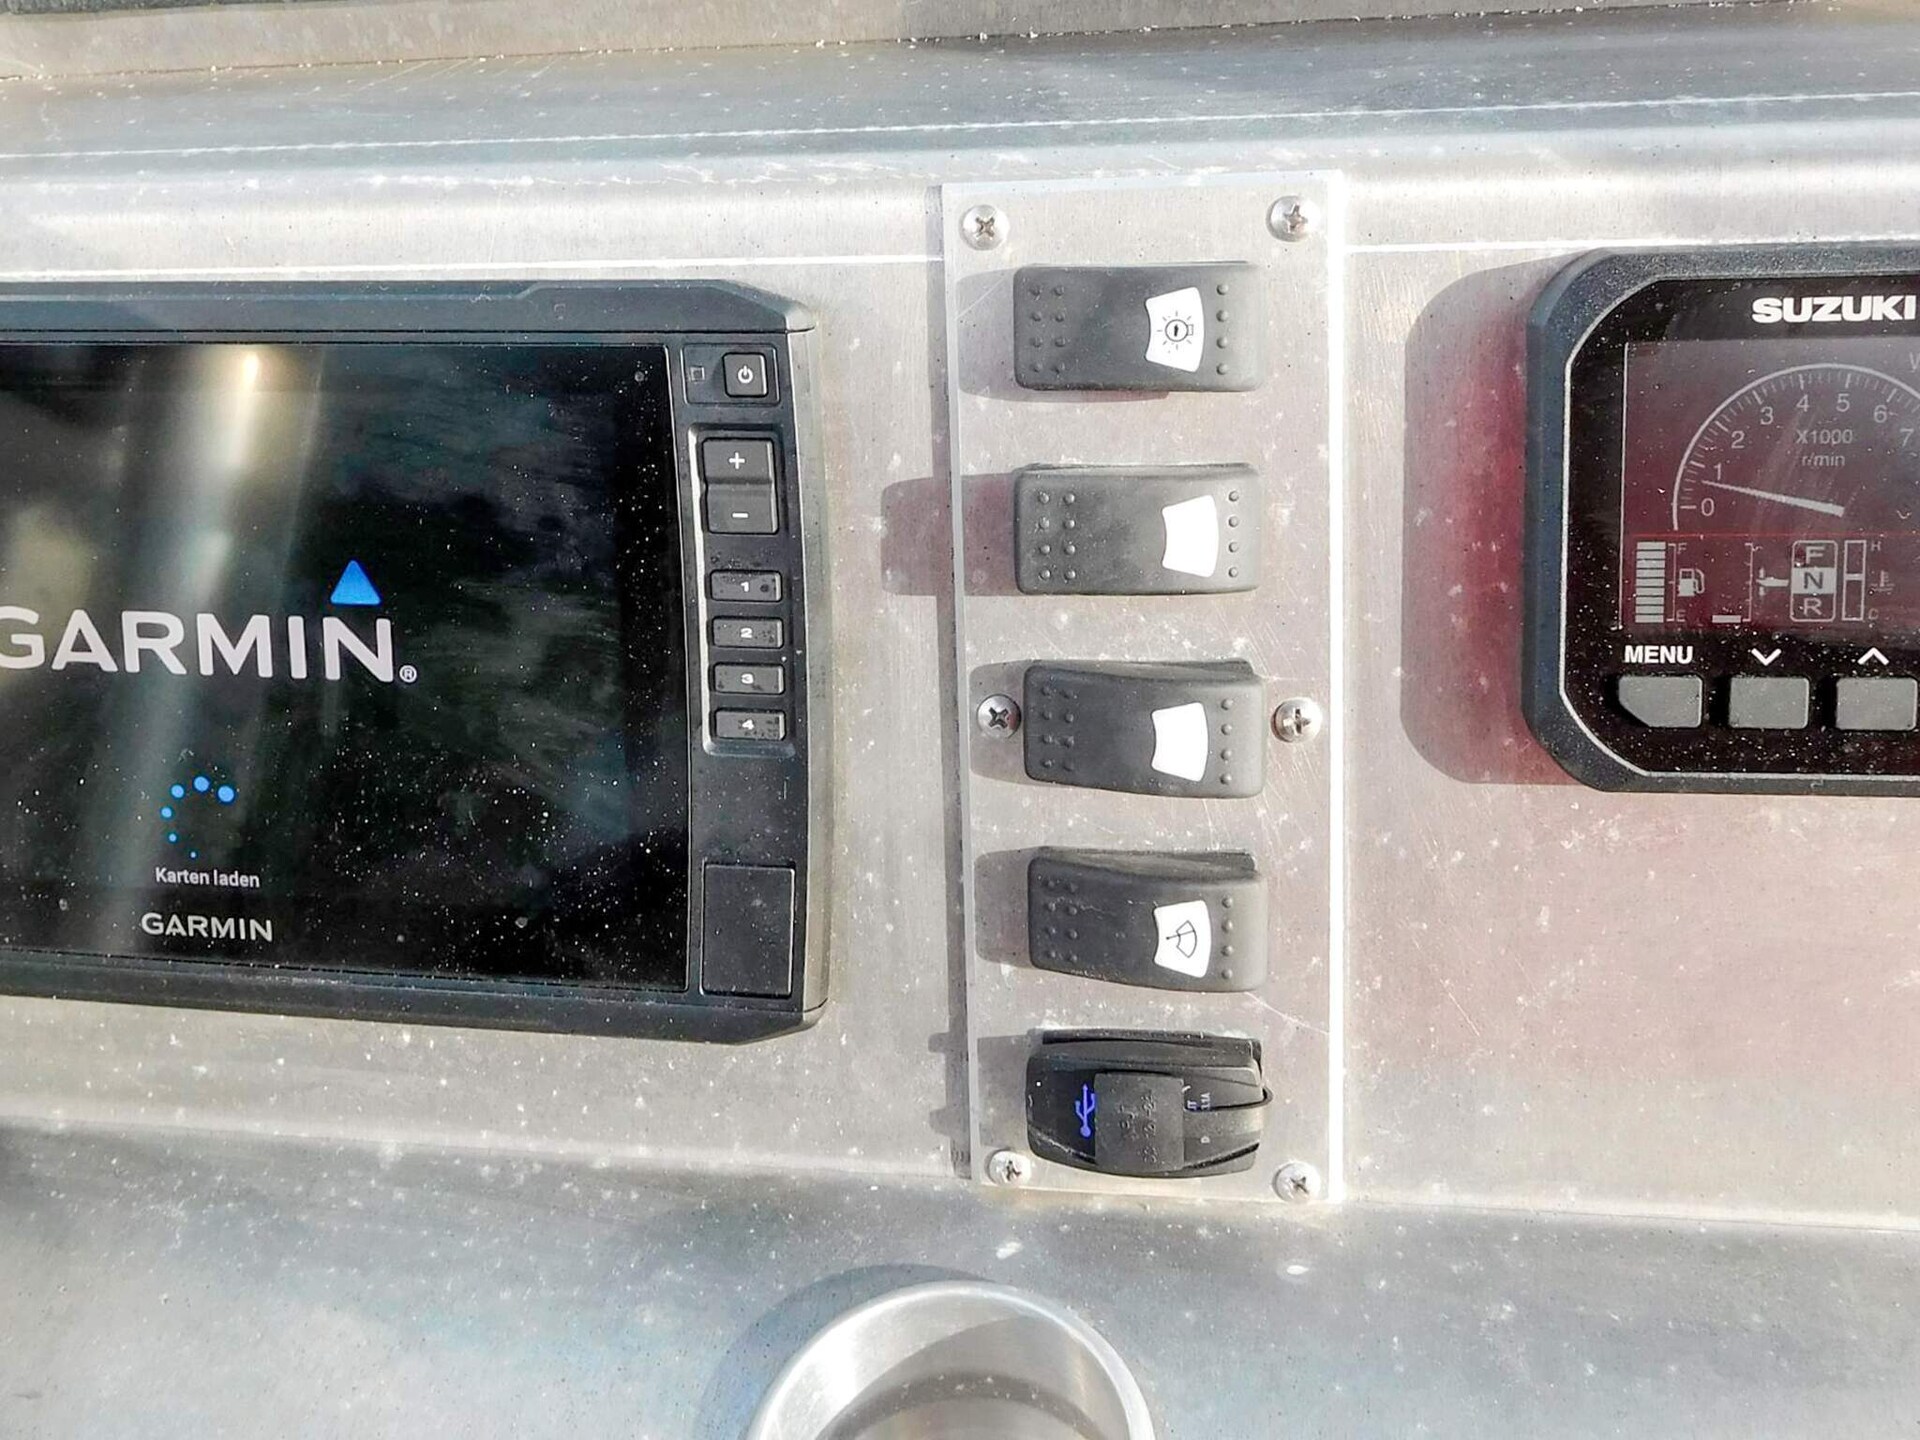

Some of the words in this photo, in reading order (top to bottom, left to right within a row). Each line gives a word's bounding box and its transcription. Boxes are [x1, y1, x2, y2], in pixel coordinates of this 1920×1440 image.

[1752, 294, 1915, 323] SUZUKI
[1795, 428, 1853, 445] X1000
[1701, 498, 1715, 517] 0
[1714, 463, 1723, 481] 1
[1731, 430, 1746, 449] 2
[1760, 406, 1775, 425] 3
[1796, 394, 1810, 412] 4
[1836, 393, 1850, 412] 5
[1874, 404, 1888, 423] 6
[1900, 428, 1915, 447] 7
[1801, 451, 1846, 468] r/min
[1805, 545, 1825, 564] F
[739, 581, 750, 592] 1
[1803, 571, 1823, 590] N
[1803, 599, 1822, 616] R
[740, 628, 753, 638] 2
[1624, 645, 1694, 665] MENU
[740, 673, 754, 684] 3
[155, 866, 210, 887] Karten
[213, 868, 261, 888] laden
[141, 911, 274, 943] GARMIN
